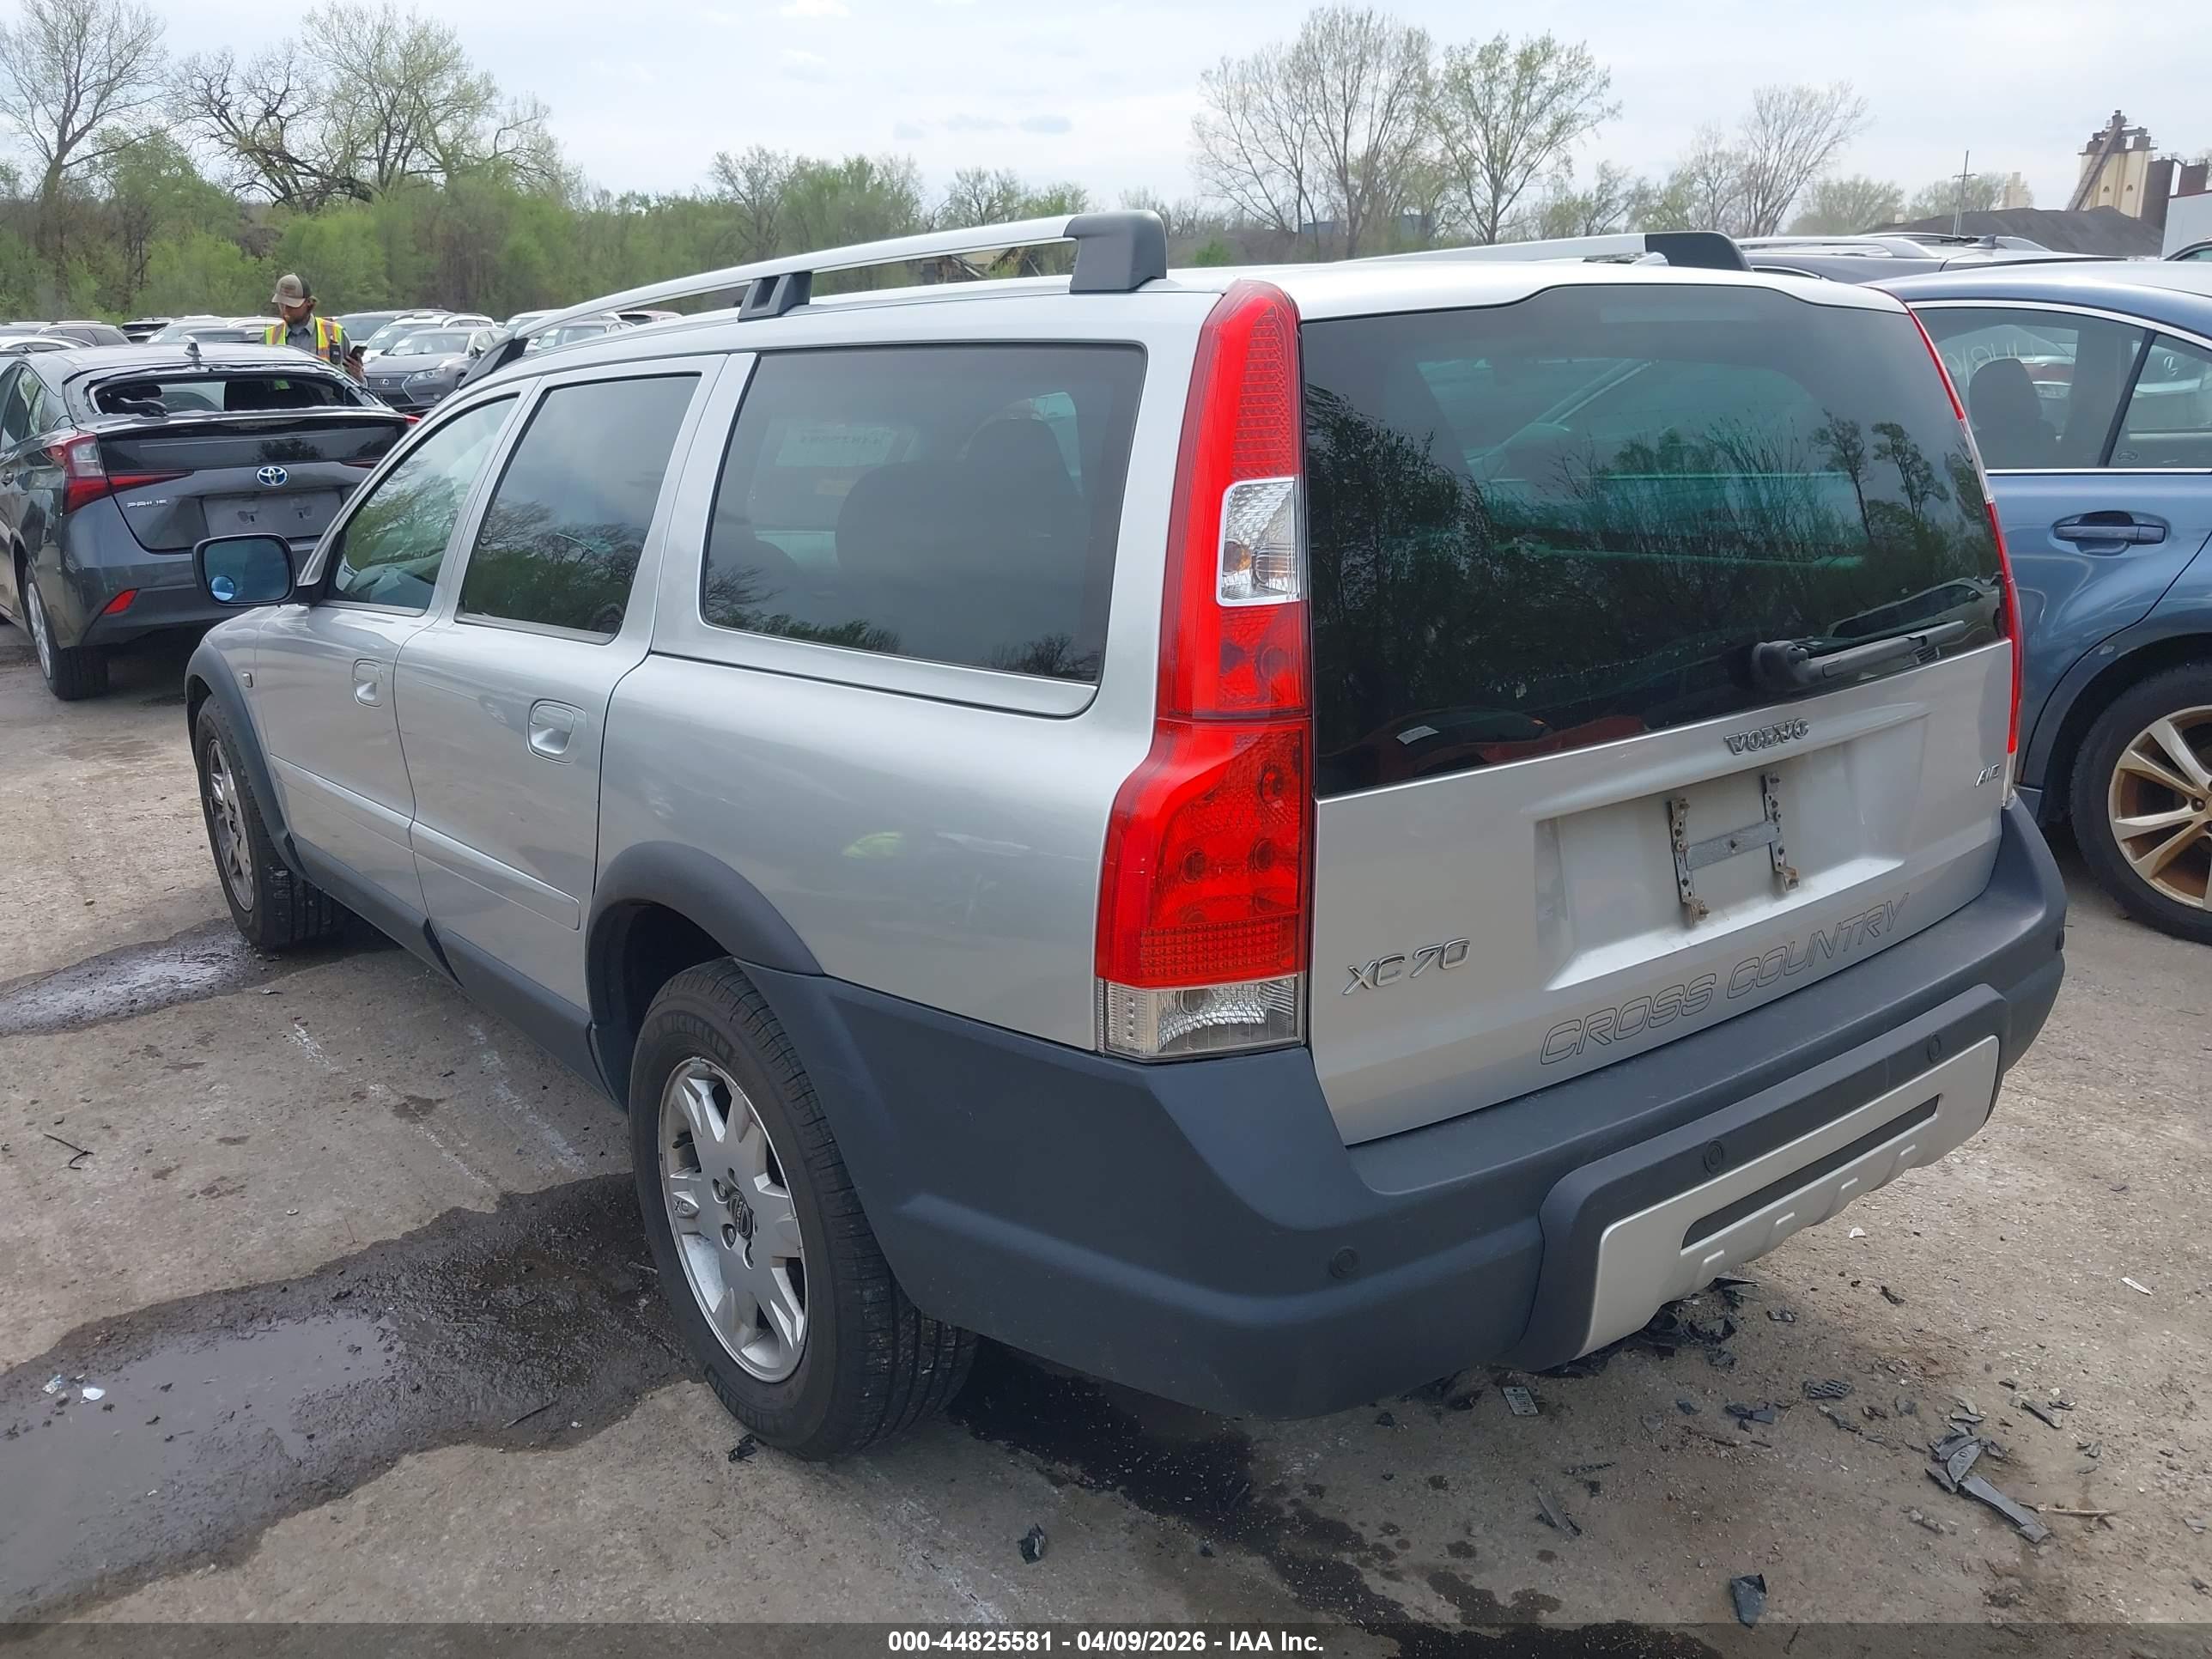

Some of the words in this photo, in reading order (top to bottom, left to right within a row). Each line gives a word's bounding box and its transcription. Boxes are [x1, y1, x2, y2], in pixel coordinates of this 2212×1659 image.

[1723, 718, 1809, 756] VOLVO
[1540, 973, 1717, 1065] CROSS
[1727, 893, 1909, 1000] COUNTRY
